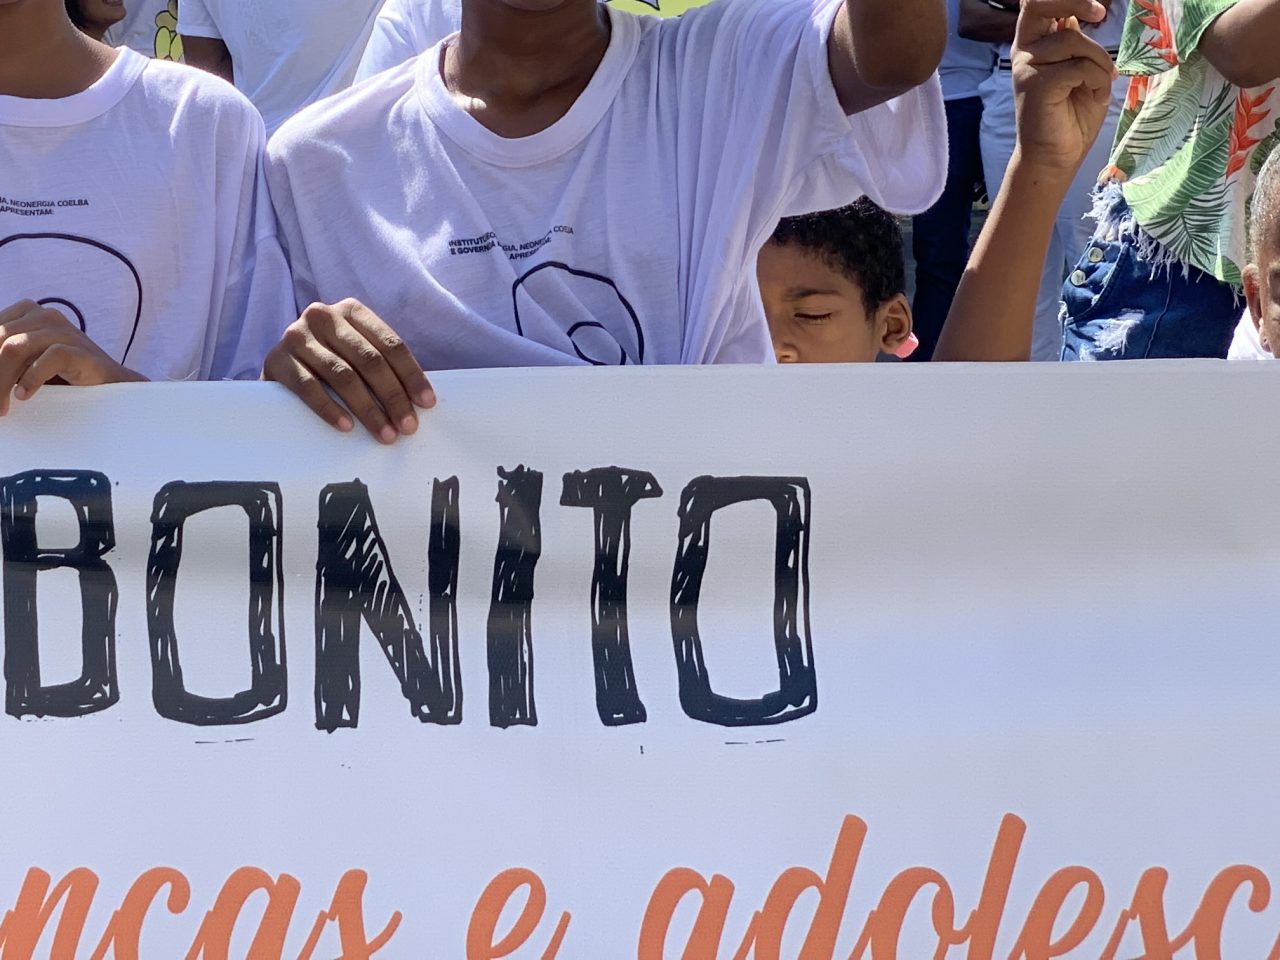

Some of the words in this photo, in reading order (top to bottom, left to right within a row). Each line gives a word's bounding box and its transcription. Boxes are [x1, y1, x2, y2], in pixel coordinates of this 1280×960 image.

[57, 199, 90, 207] COELBA
[466, 867, 571, 960] e
[637, 812, 1280, 960] adolesc
